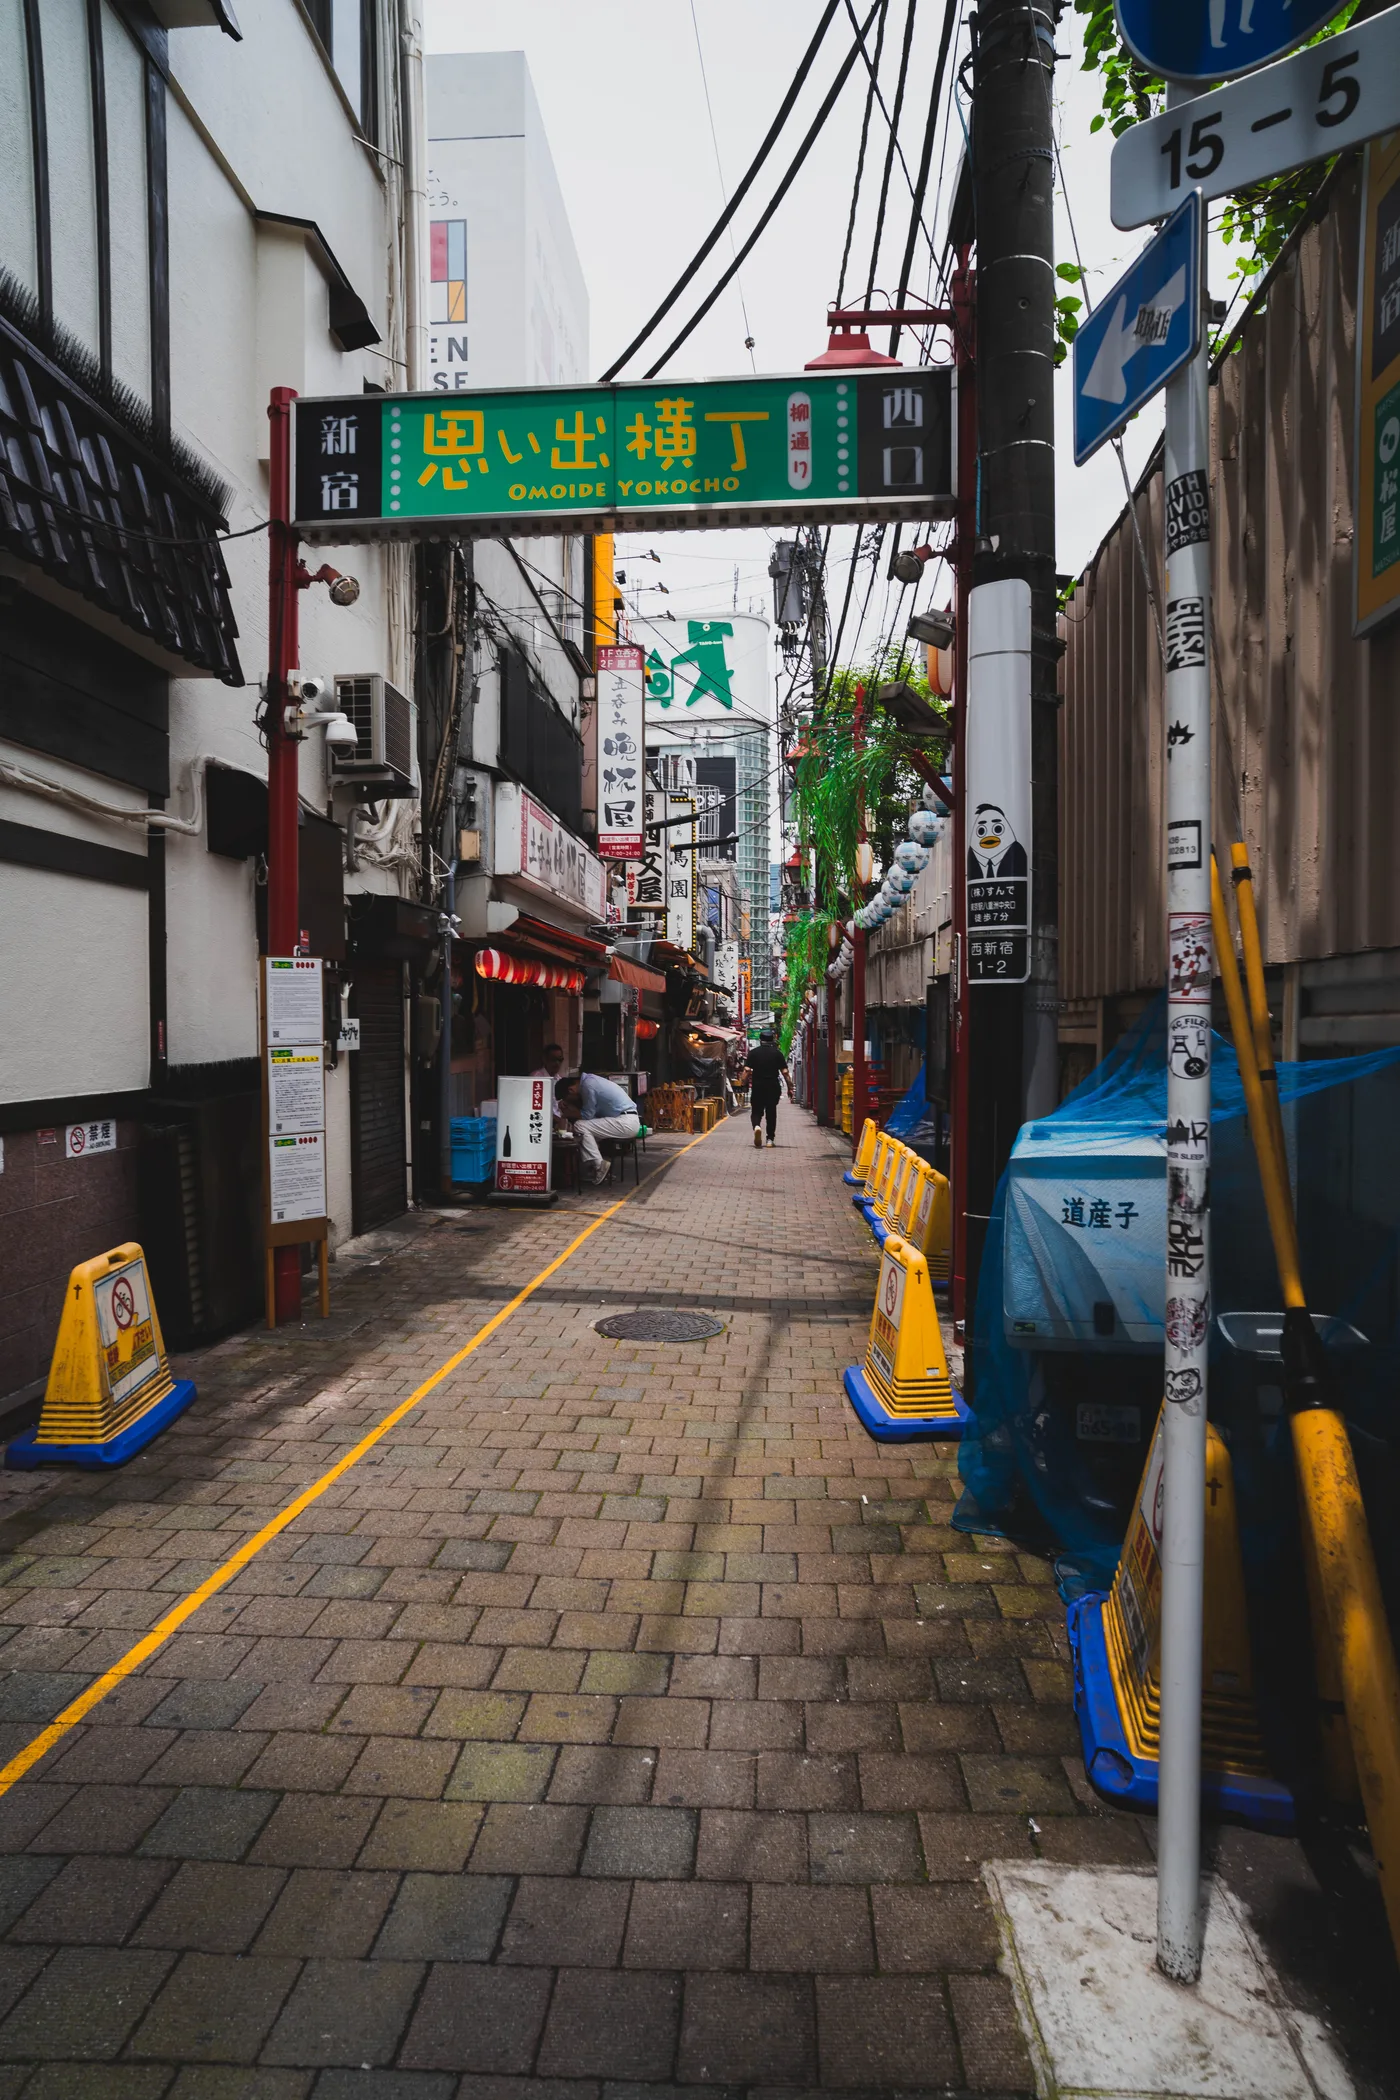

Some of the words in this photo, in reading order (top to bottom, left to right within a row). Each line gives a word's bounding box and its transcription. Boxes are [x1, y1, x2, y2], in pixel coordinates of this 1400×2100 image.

[320, 414, 360, 512] 新宿
[418, 398, 770, 490] 思い出横丁
[789, 403, 811, 480] 柳通り
[882, 386, 924, 487] 西口
[508, 481, 607, 501] OMOIDE
[617, 475, 740, 498] YOKOCHO
[1380, 467, 1399, 543] 松屋
[971, 941, 1014, 956] 西新宿
[977, 960, 1007, 974] 1-2
[89, 1122, 111, 1141] 禁煙
[1061, 1197, 1140, 1231] 道産子
